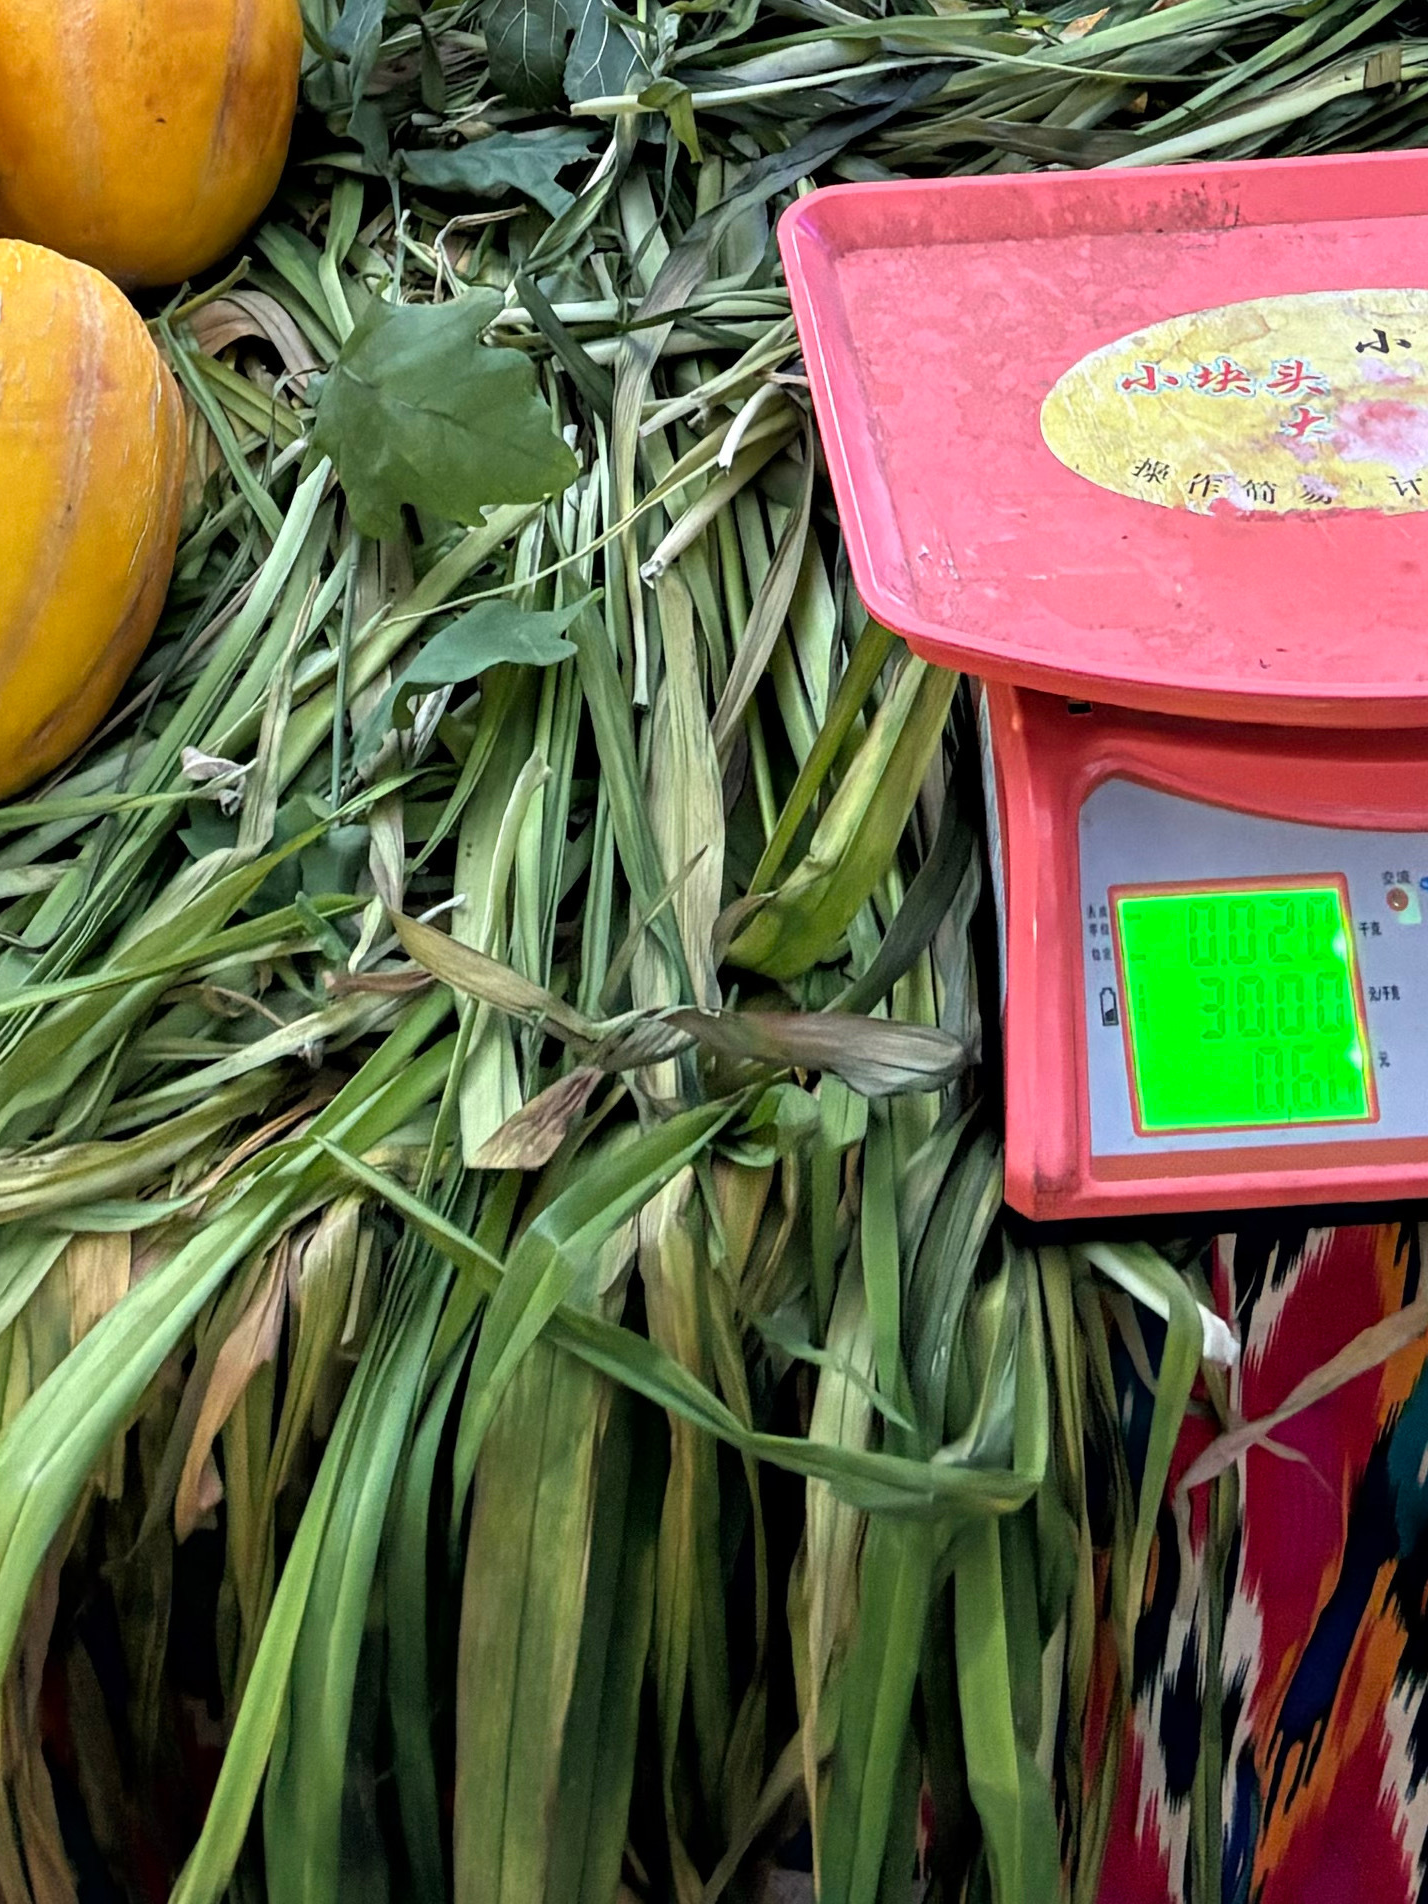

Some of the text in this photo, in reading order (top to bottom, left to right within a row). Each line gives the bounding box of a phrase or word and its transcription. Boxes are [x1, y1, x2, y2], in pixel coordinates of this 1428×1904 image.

[1121, 359, 1326, 395] 小块头
[1358, 921, 1382, 937] 千克
[1200, 972, 1344, 1040] 30.00
[1379, 1051, 1390, 1068] 元
